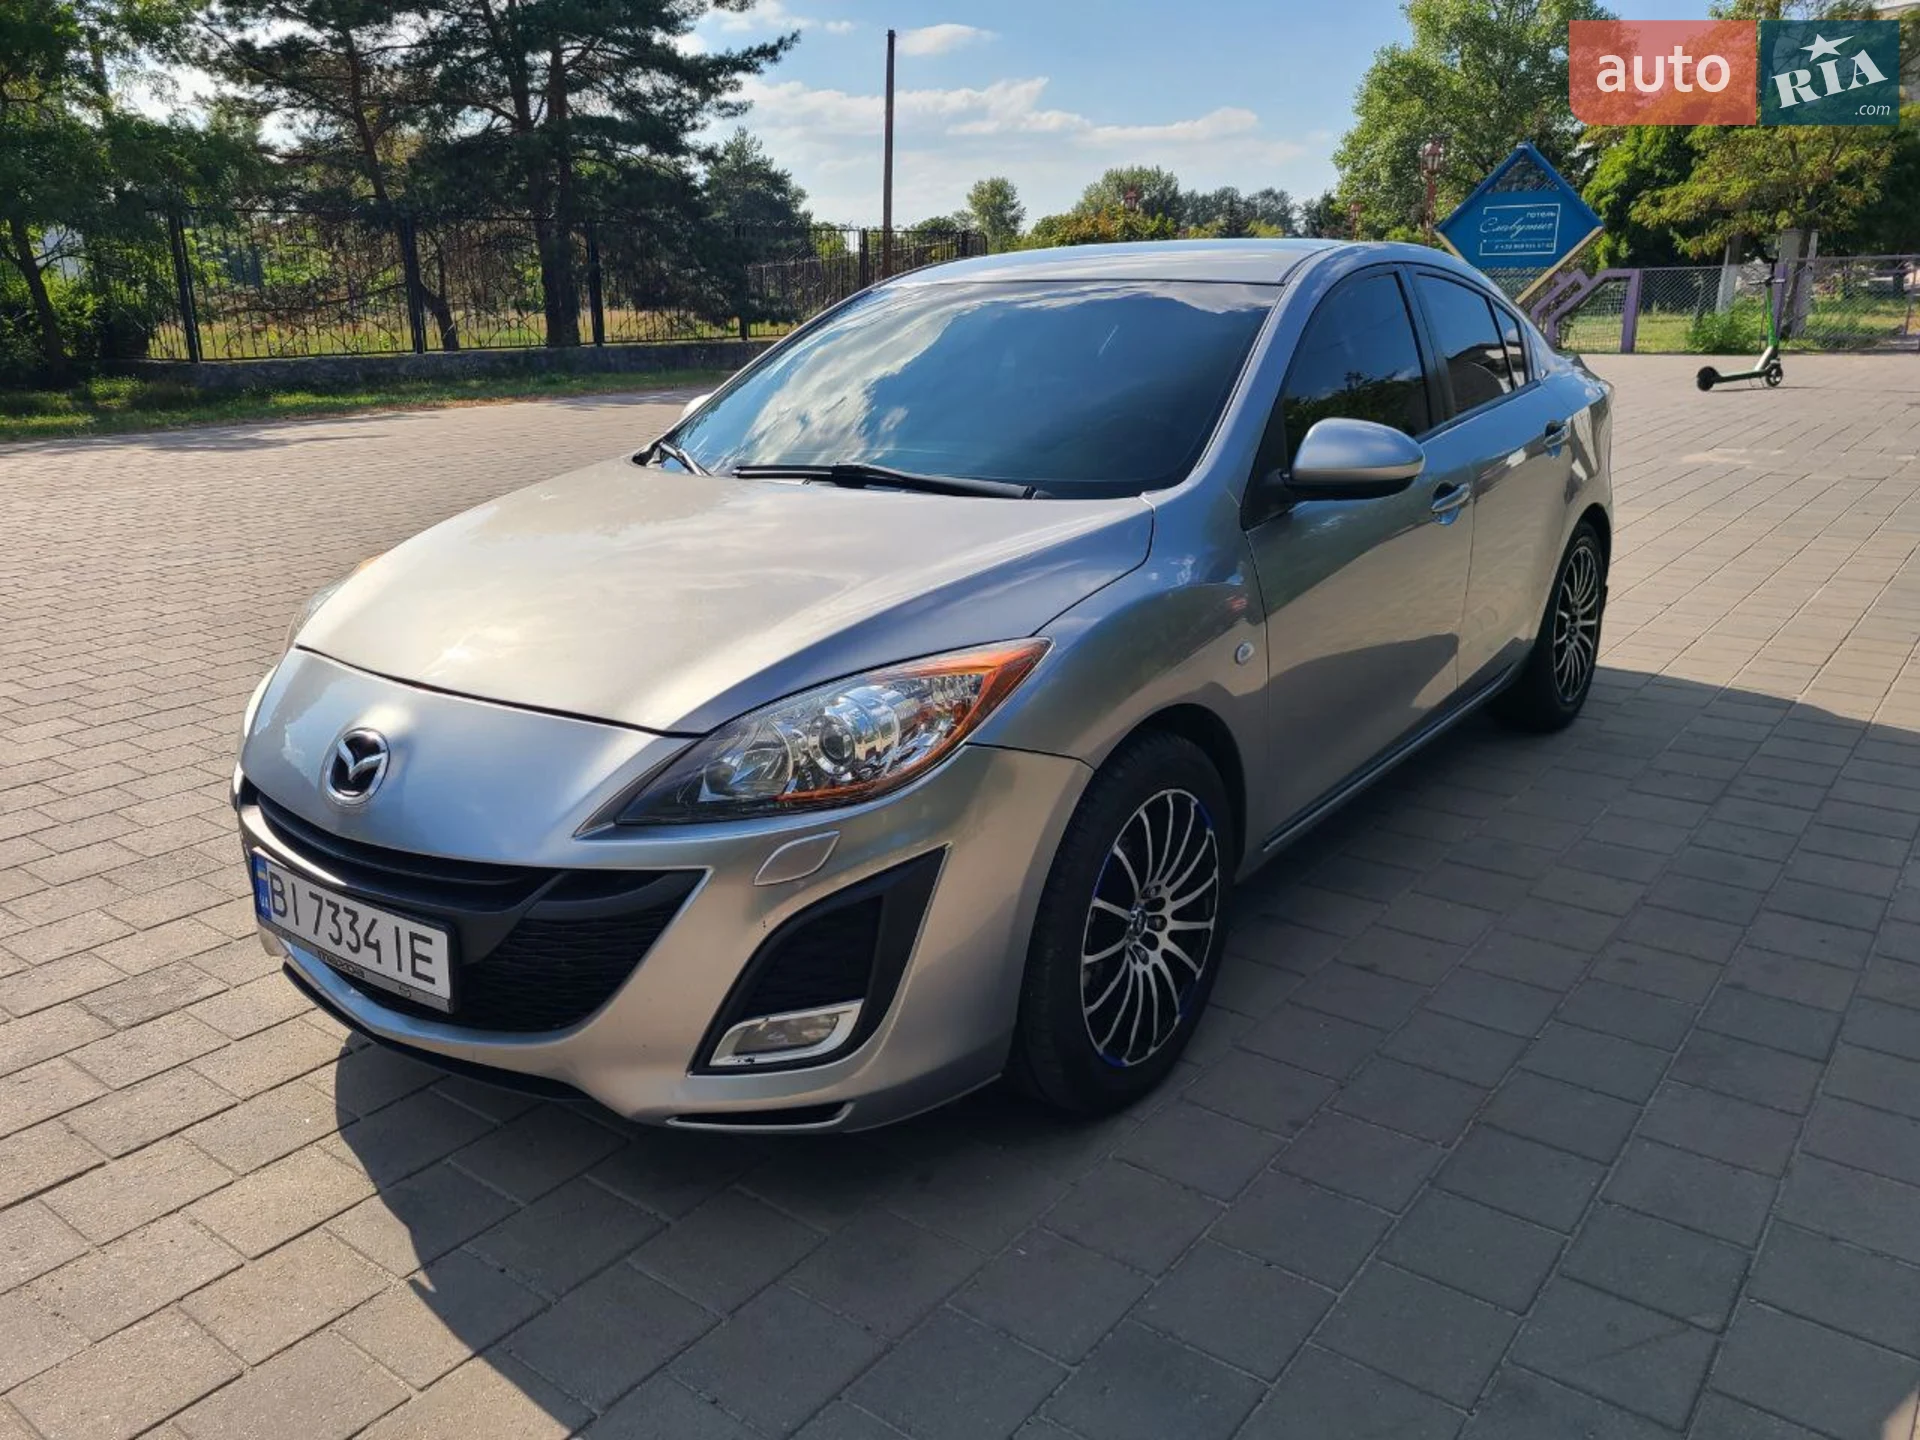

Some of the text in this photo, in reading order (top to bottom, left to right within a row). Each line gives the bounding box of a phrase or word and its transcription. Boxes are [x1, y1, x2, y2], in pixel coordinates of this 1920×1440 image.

[269, 871, 436, 985] BI 7334 IE
